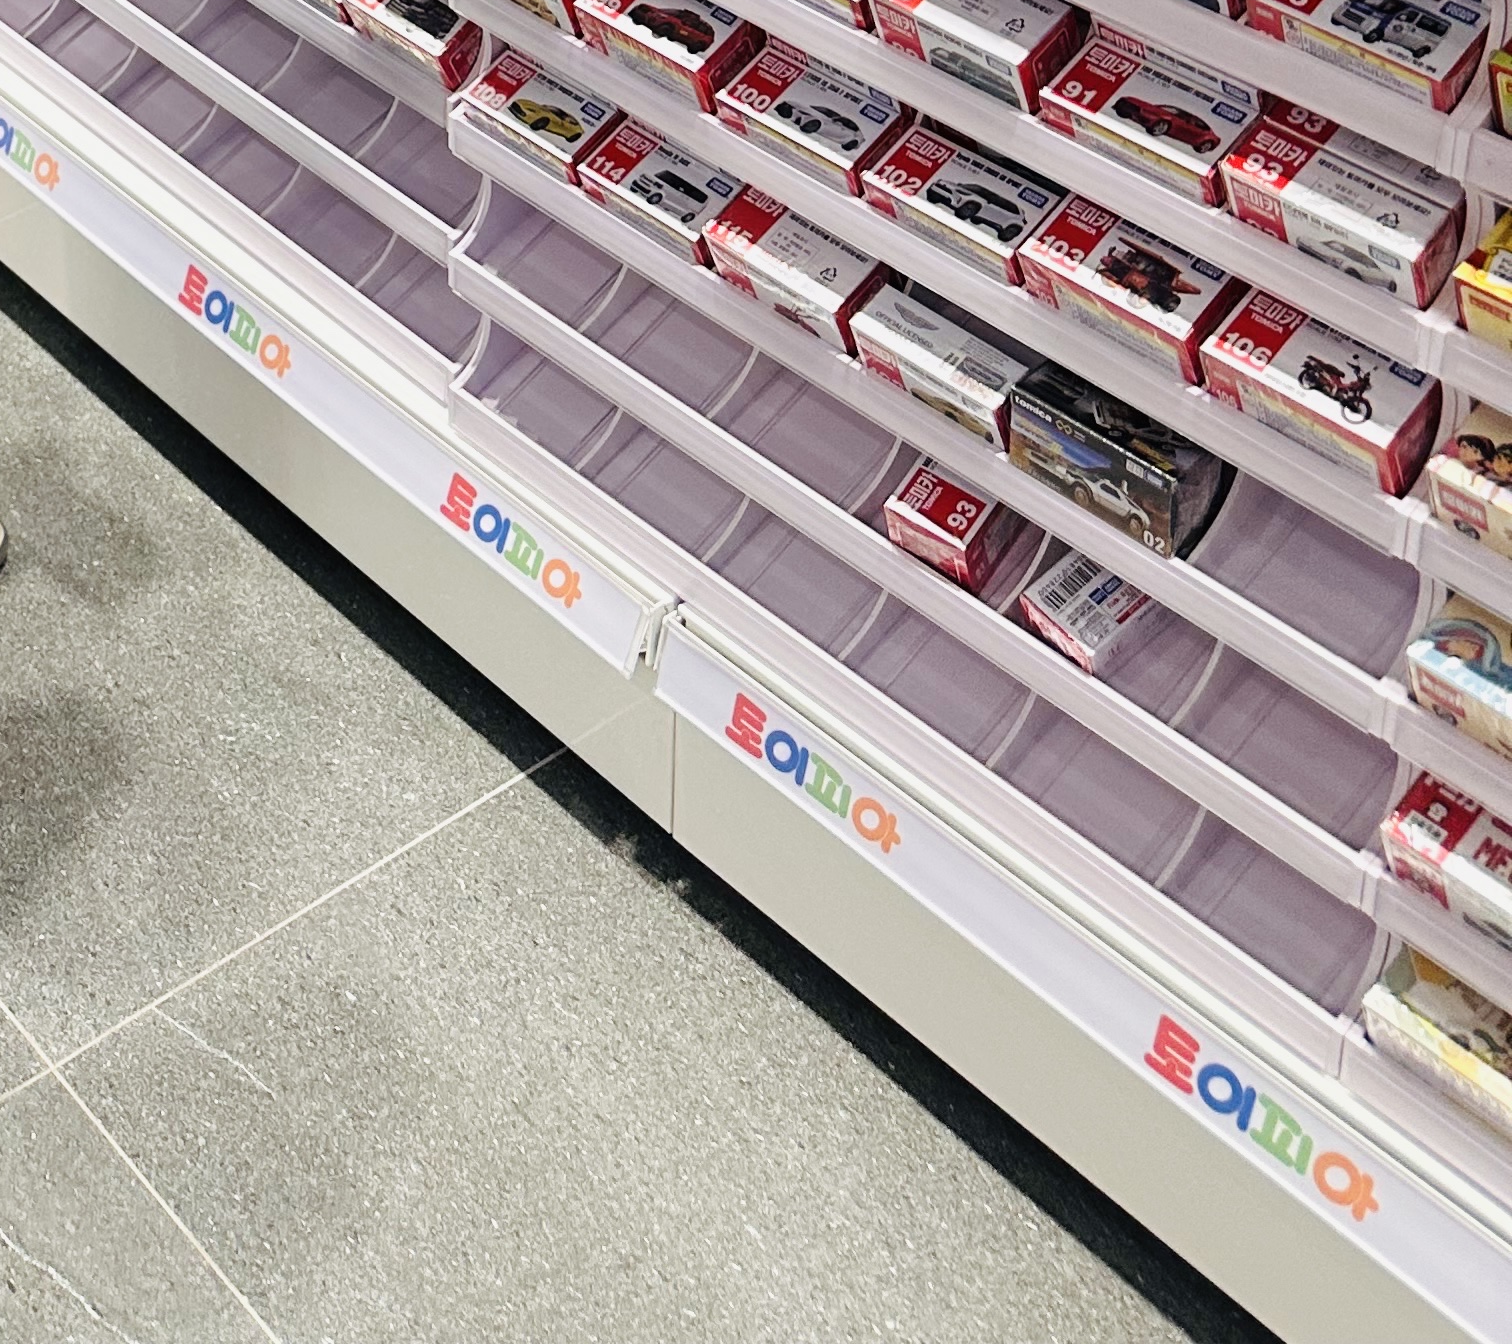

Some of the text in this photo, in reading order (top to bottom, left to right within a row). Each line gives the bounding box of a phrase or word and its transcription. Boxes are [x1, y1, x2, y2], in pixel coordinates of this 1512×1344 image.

[758, 56, 801, 81] 토미카
[1087, 46, 1136, 78] 토미카
[472, 84, 507, 110] 108
[731, 85, 772, 111] 100
[1061, 80, 1098, 106] 91
[1287, 107, 1327, 134] 93
[617, 130, 653, 154] 토미카
[905, 133, 955, 166] 토미카
[1251, 130, 1309, 167] 토미카
[593, 156, 626, 182] 114
[881, 164, 923, 194] 102
[1240, 153, 1285, 182] 93
[1066, 197, 1116, 234] 토미카
[178, 263, 292, 380] 토이피아
[1249, 295, 1301, 331] 토미카
[1223, 331, 1274, 367] 106
[1014, 395, 1054, 424] tomica
[946, 500, 977, 531] 93
[439, 471, 583, 610] 토이피아
[1142, 530, 1167, 555] 02
[725, 692, 902, 856] 토이피아
[1143, 1013, 1380, 1223] 토이피아
